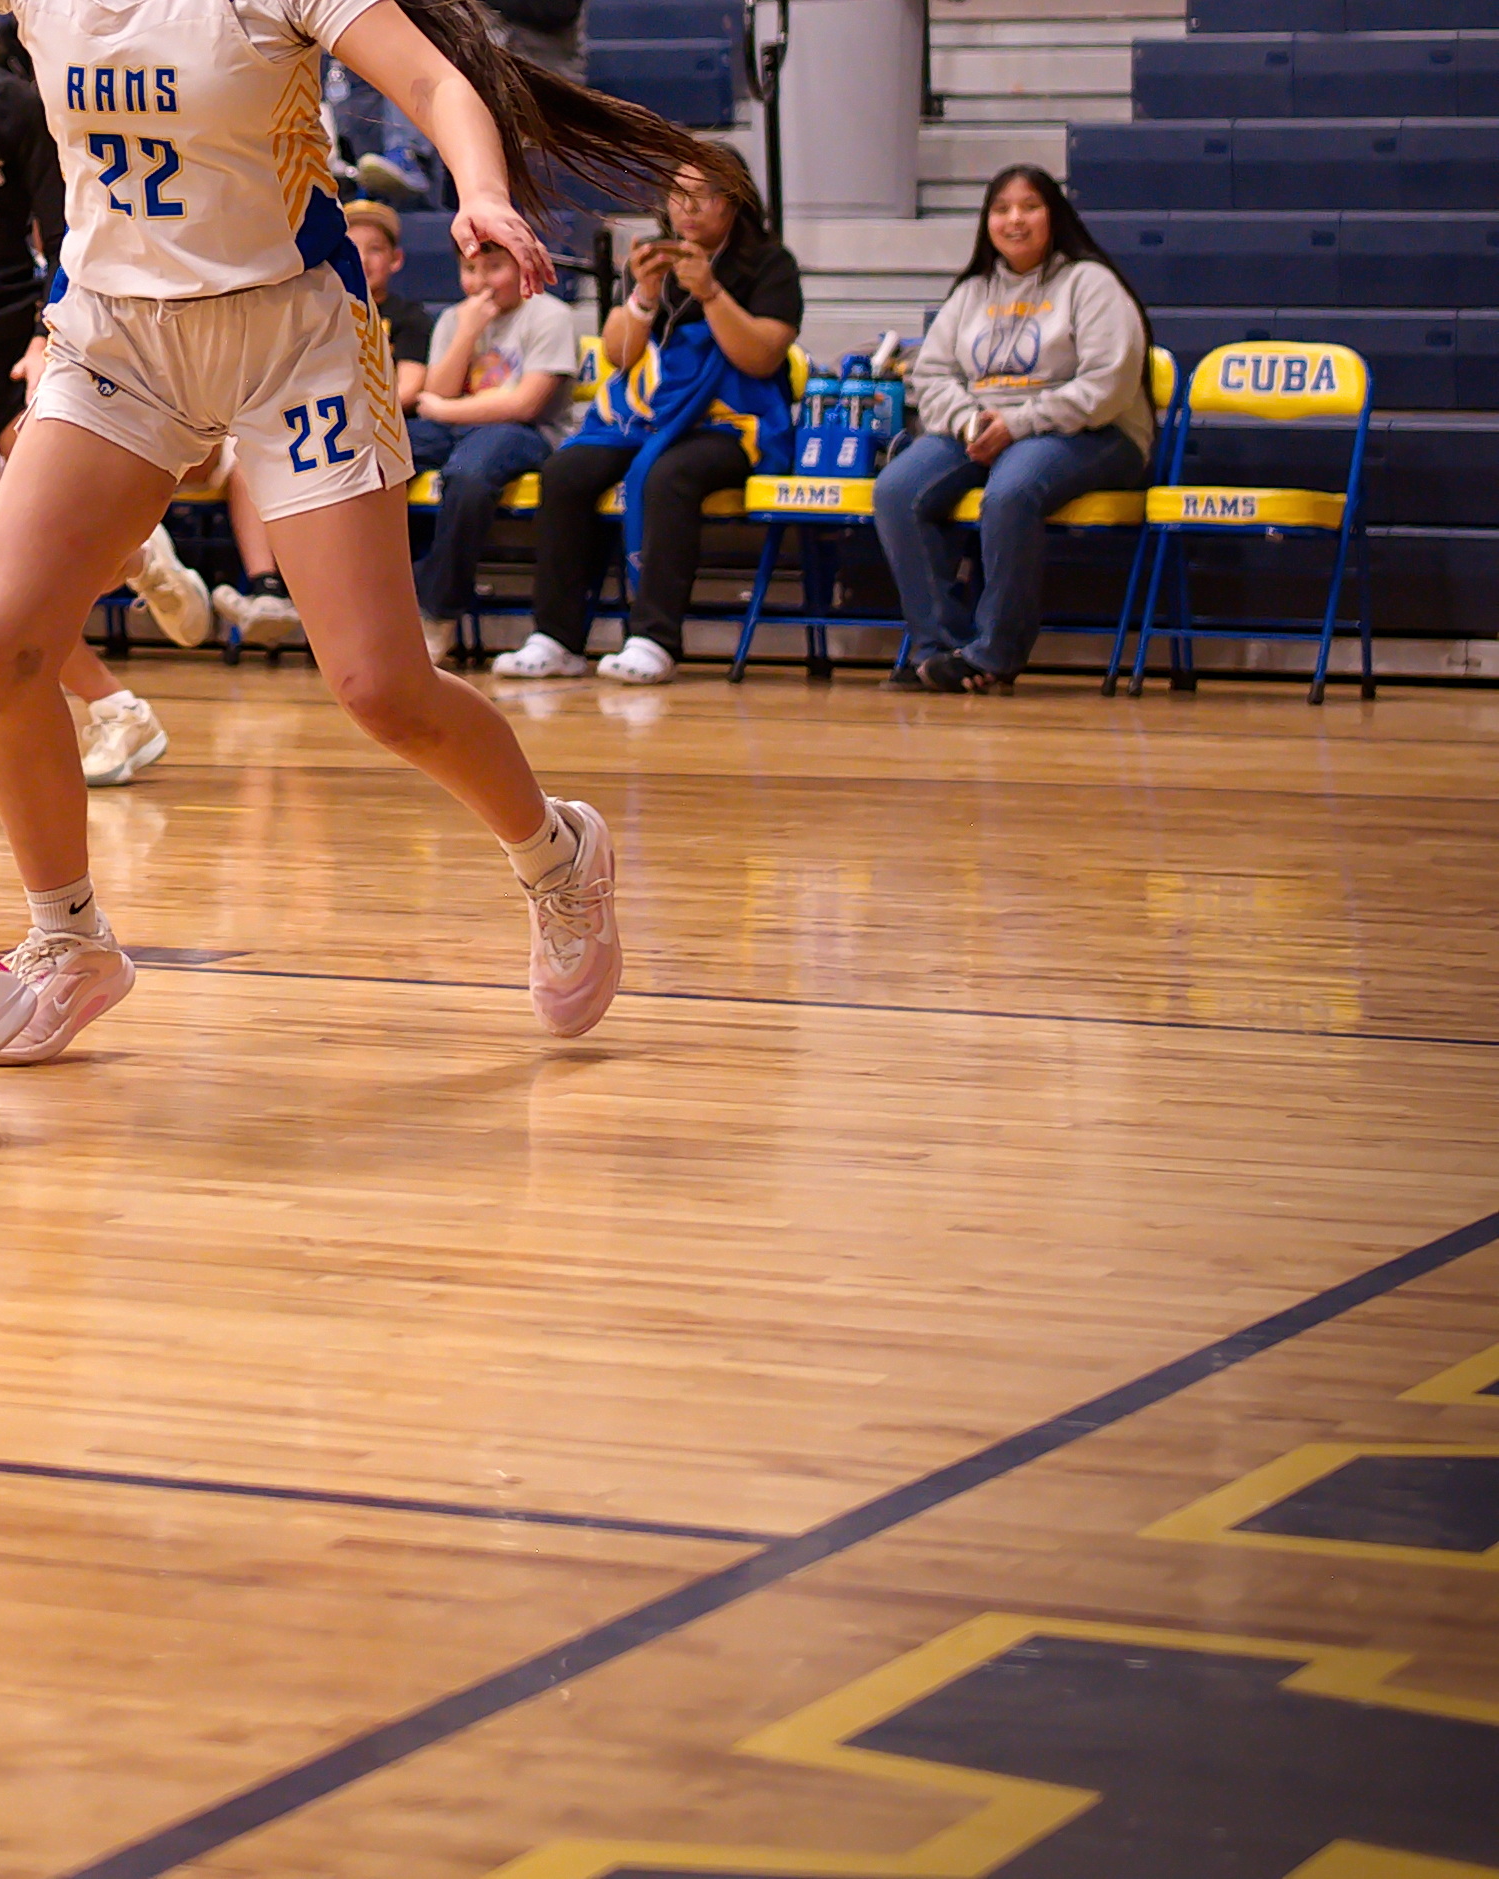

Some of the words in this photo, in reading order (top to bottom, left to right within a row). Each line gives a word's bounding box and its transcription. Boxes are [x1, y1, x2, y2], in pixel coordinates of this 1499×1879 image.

[66, 63, 180, 114] RAMS
[85, 131, 187, 220] 22
[1219, 353, 1338, 395] CUBA
[280, 392, 357, 476] 22
[775, 483, 841, 506] RAMS
[1182, 494, 1256, 518] RAMS
